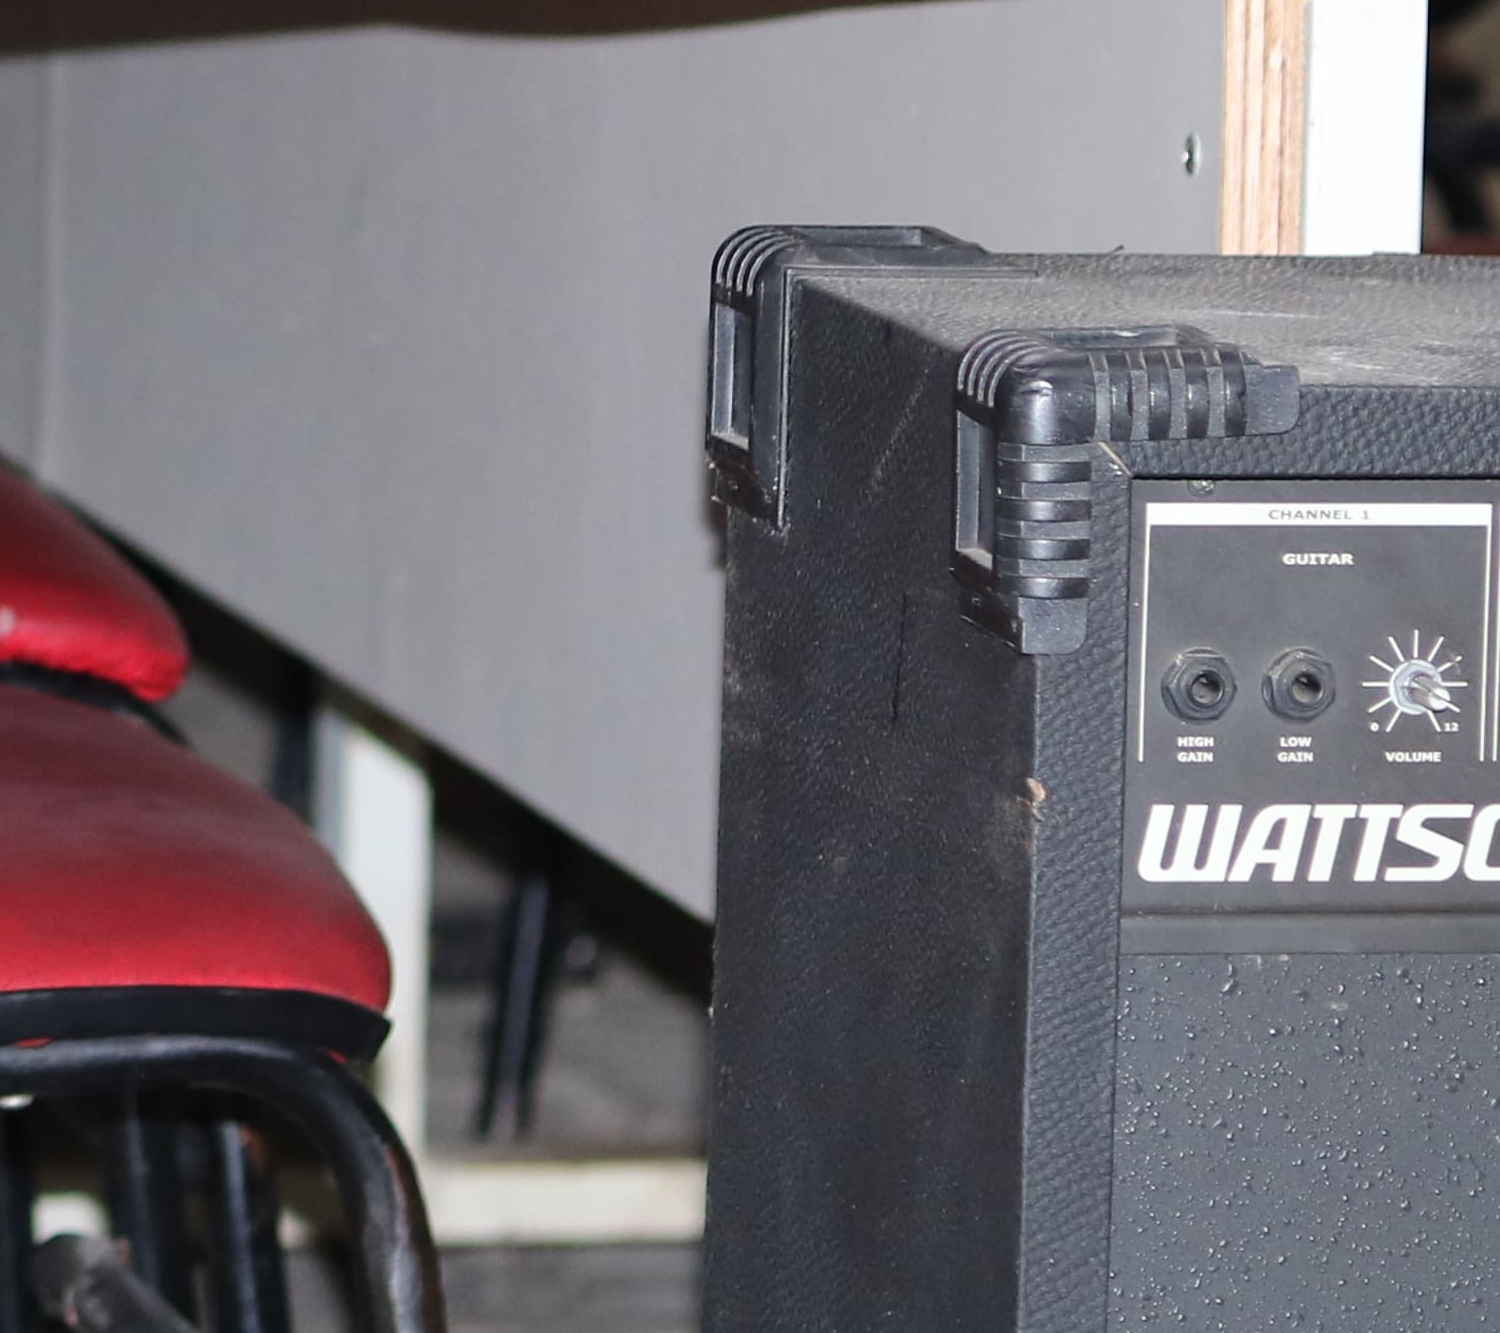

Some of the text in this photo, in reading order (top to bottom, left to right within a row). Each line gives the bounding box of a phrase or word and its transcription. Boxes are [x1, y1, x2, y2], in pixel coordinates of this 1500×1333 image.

[1268, 509, 1371, 521] CHANNEL 1
[1282, 552, 1355, 566] GUITAR
[1369, 722, 1379, 732] 0
[1444, 722, 1459, 732] 12
[1177, 736, 1214, 748] HIGH
[1280, 736, 1312, 748] LOW
[1177, 751, 1214, 763] GAIN
[1277, 751, 1314, 763] GAIN
[1385, 751, 1442, 763] VOLUME
